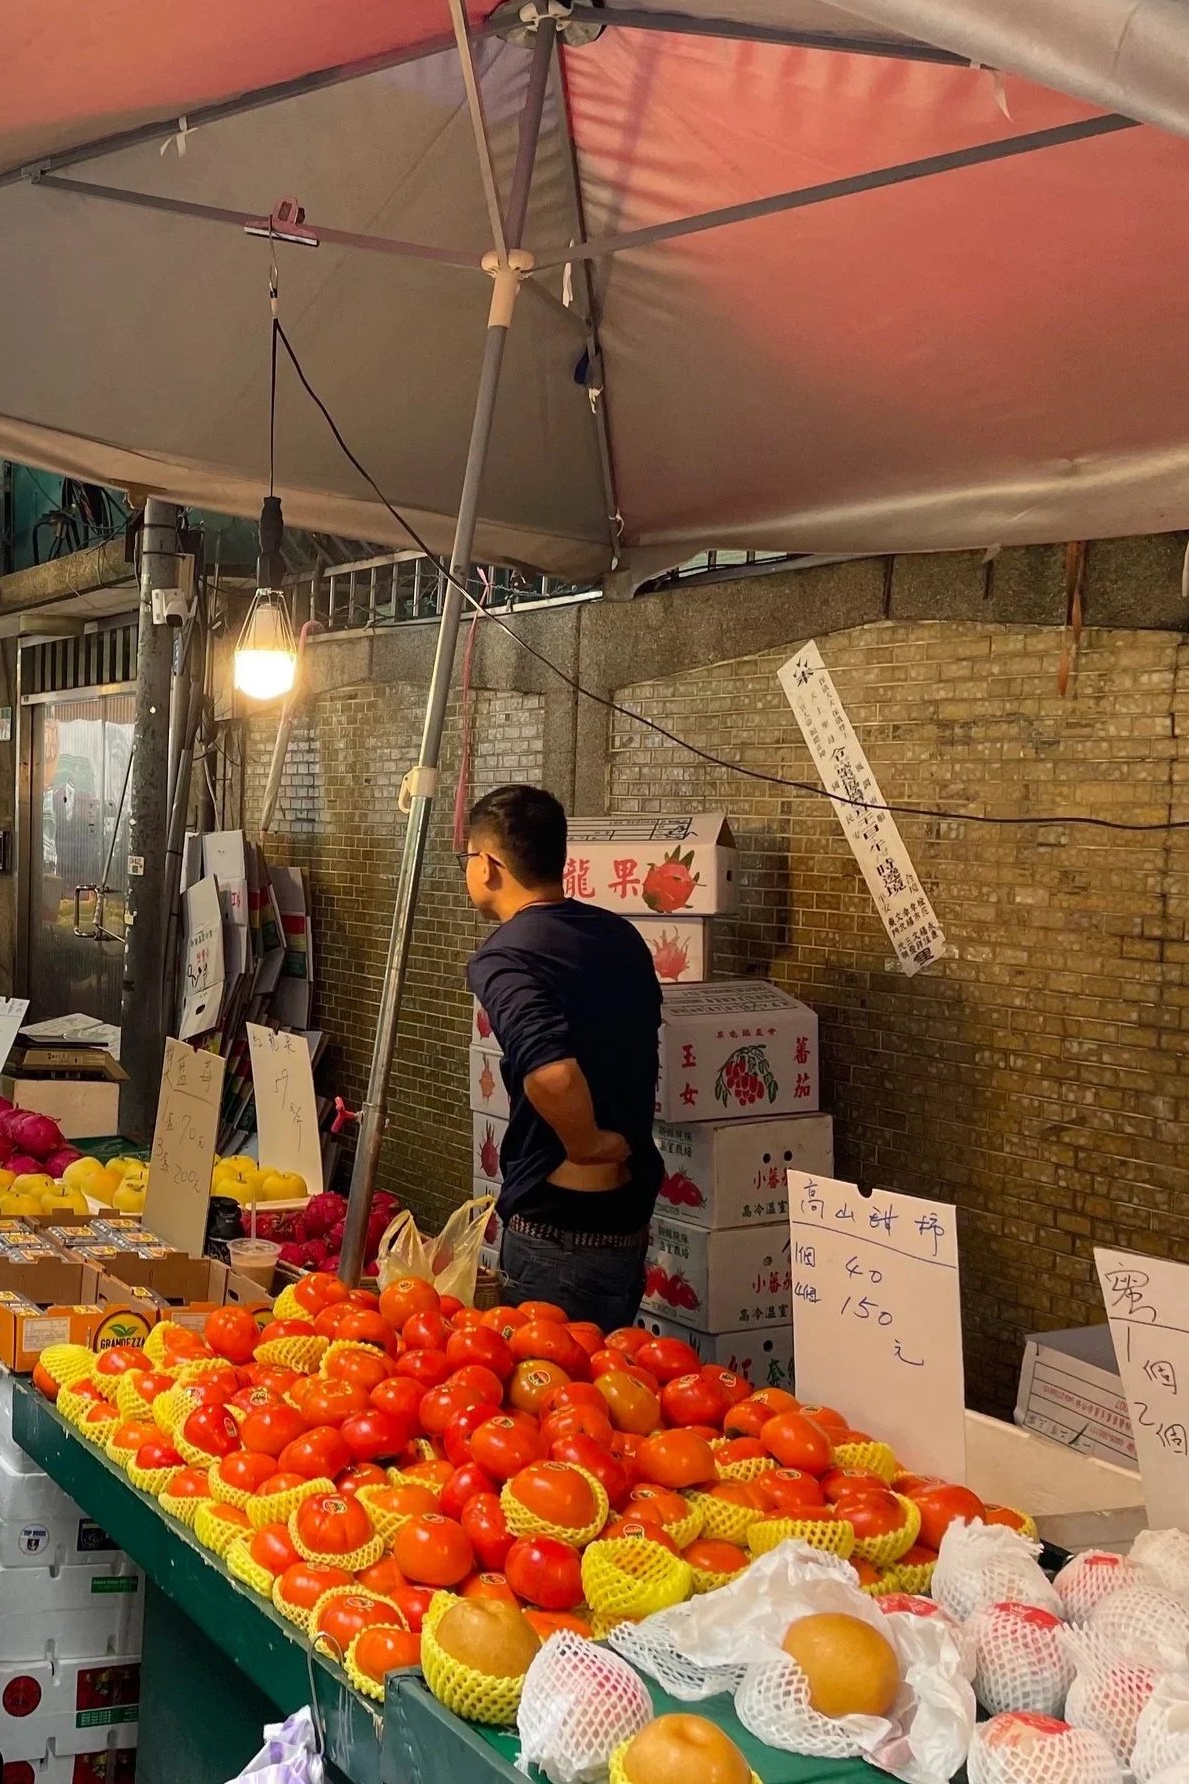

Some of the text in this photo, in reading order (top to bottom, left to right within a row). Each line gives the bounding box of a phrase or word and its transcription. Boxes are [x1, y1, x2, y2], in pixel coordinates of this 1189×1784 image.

[679, 1043, 698, 1106] 玉女
[845, 1256, 883, 1284] 40
[840, 1296, 893, 1326] 150
